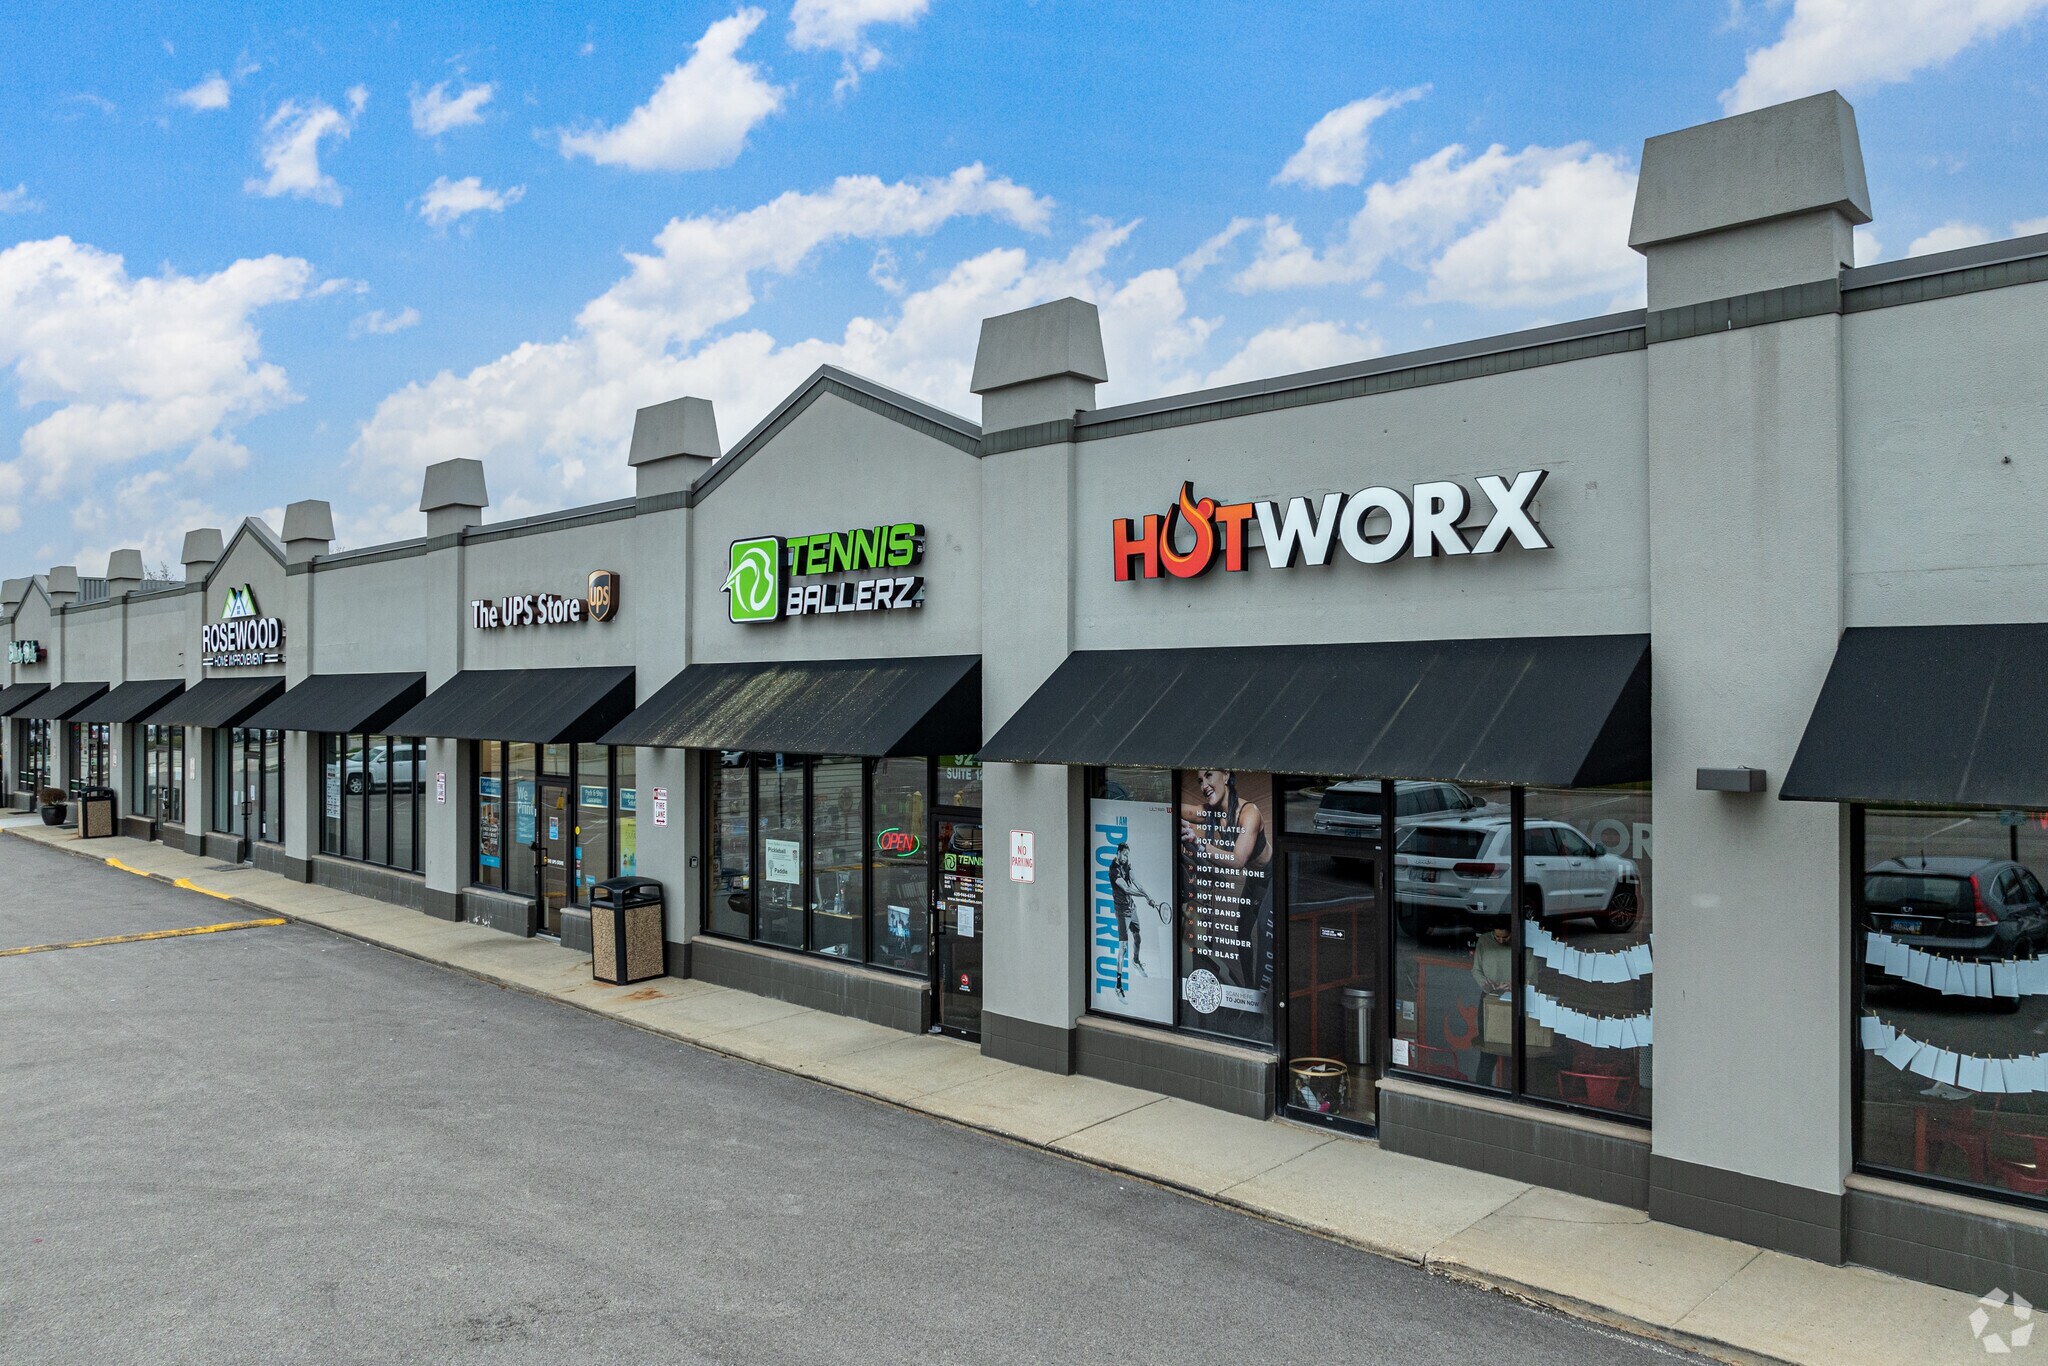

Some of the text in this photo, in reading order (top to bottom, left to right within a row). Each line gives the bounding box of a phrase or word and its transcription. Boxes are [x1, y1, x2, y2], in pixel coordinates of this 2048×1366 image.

[1113, 470, 1553, 581] HOTWORX
[786, 523, 918, 576] TENNIS
[590, 586, 609, 613] ups
[786, 577, 918, 616] BALLERZ
[471, 593, 580, 628] The UPS Store
[202, 618, 279, 653] ROSEWOOD
[214, 652, 264, 667] HOME IMPROVEMENT
[946, 767, 972, 780] SUITE
[517, 786, 529, 800] We
[517, 802, 534, 816] Print
[655, 802, 666, 810] FIRE
[1120, 816, 1128, 826] AM
[1214, 826, 1246, 834] PILATES
[881, 832, 914, 851] OPEN
[1017, 845, 1027, 856] NO
[1012, 856, 1033, 868] PARKING
[1214, 853, 1235, 861] BUNS
[774, 867, 788, 875] Paddle
[1214, 867, 1240, 876] BARRE
[1242, 870, 1265, 878] NONE
[1214, 881, 1235, 889] CORE
[1214, 895, 1251, 905] WARRIOR
[1095, 823, 1129, 994] POWERFUL
[1214, 909, 1241, 918] BANDS
[1197, 920, 1239, 932] HOT CYCLE
[1197, 934, 1251, 948] HOT THUNDER
[1197, 948, 1240, 960] HOT BLAST
[1225, 990, 1239, 998] SCAN
